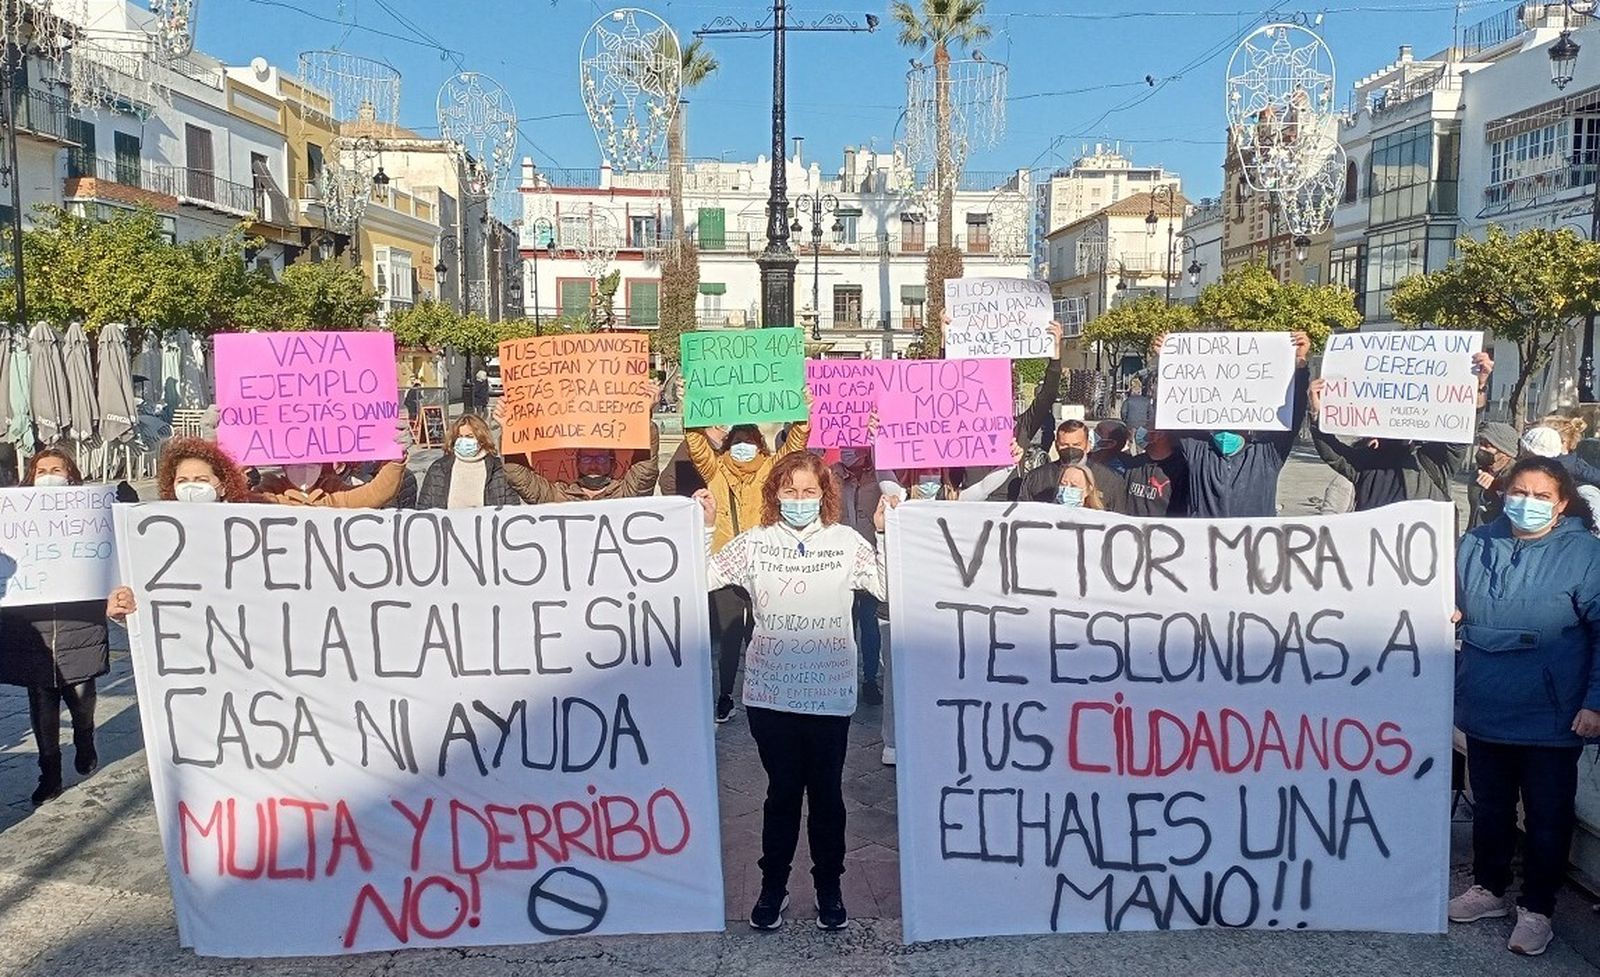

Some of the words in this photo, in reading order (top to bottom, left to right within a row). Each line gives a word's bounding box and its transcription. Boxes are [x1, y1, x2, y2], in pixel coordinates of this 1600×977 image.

[965, 281, 994, 296] LOS
[1006, 295, 1045, 311] PARA
[1005, 328, 1022, 341] NO
[1163, 334, 1191, 355] SIN
[1198, 336, 1231, 355] DAR
[1237, 336, 1260, 356] LA
[1330, 336, 1354, 351] LA
[1360, 333, 1437, 352] VIVIENDA
[1444, 335, 1472, 353] UN
[267, 334, 351, 367] VAYA
[503, 342, 537, 361] TUS
[686, 335, 759, 361] ERROR
[969, 341, 1011, 355] HACES
[504, 359, 580, 382] NECESITAN
[587, 359, 597, 374] Y
[626, 359, 647, 375] NO
[688, 362, 784, 389] ALCALDE
[808, 365, 874, 379] IUDADAN
[876, 359, 983, 394] VICTOR
[1162, 363, 1207, 380] CARA
[1216, 363, 1240, 380] NO
[1246, 362, 1274, 380] SE
[1364, 355, 1449, 378] DERECHO,
[240, 369, 378, 400] EJEMPLO
[507, 379, 554, 404] ESTÁS
[559, 379, 599, 397] PARA
[1165, 386, 1222, 404] AYUDA
[1231, 387, 1257, 404] AL
[1324, 377, 1347, 398] MI
[1352, 376, 1429, 402] VIVIENDA
[1436, 383, 1474, 404] UNA
[222, 405, 268, 426] QUE
[279, 400, 346, 423] ESTÁS
[352, 401, 399, 420] DANDO
[579, 400, 644, 415] QUEREMOS
[689, 396, 724, 419] NOT
[738, 390, 801, 415] FOUND
[818, 401, 873, 414] ALCALD
[914, 388, 993, 419] MORA
[1177, 405, 1275, 424] CIUDADANO
[1325, 402, 1380, 427] RUINA
[512, 427, 529, 443] UN
[534, 424, 586, 440] ALCALDE
[820, 415, 850, 430] DAR
[877, 420, 949, 438] ATIENDE
[957, 419, 969, 433] A
[972, 416, 1012, 432] QUIEN
[243, 424, 376, 461] ALCALDE
[895, 440, 925, 462] TE
[934, 434, 997, 460] VOTA!
[0, 495, 17, 514] A
[22, 492, 37, 512] Y
[40, 489, 115, 511] DERRIBO
[4, 520, 40, 540] UNA
[49, 514, 113, 537] MISMA
[72, 541, 113, 559] ESO
[138, 515, 202, 591] 2
[223, 505, 678, 593] PENSIONISTAS
[936, 503, 1188, 597] VÍCTOR
[1208, 524, 1353, 594] MORA
[1367, 521, 1439, 588] NO
[778, 577, 806, 596] YO
[151, 600, 255, 677] EN
[282, 602, 358, 682] LA
[371, 600, 573, 678] CALLE
[585, 591, 682, 669] SIN
[935, 602, 1029, 685] TE
[1050, 609, 1372, 688] ESCONDAS,
[1377, 610, 1421, 679] A
[164, 687, 334, 770] CASA
[355, 699, 419, 775] NI
[439, 693, 649, 776] AYUDA
[936, 699, 1055, 774] TUS
[1068, 692, 1434, 781] CIUDADANOS,
[178, 796, 374, 880] MULTA
[391, 797, 435, 873] Y
[450, 784, 691, 874] DERRIBO
[940, 776, 1212, 873] ÉCHALES
[1239, 777, 1391, 861] UNA
[1050, 859, 1314, 933] MANO!!
[342, 872, 482, 948] NO!
